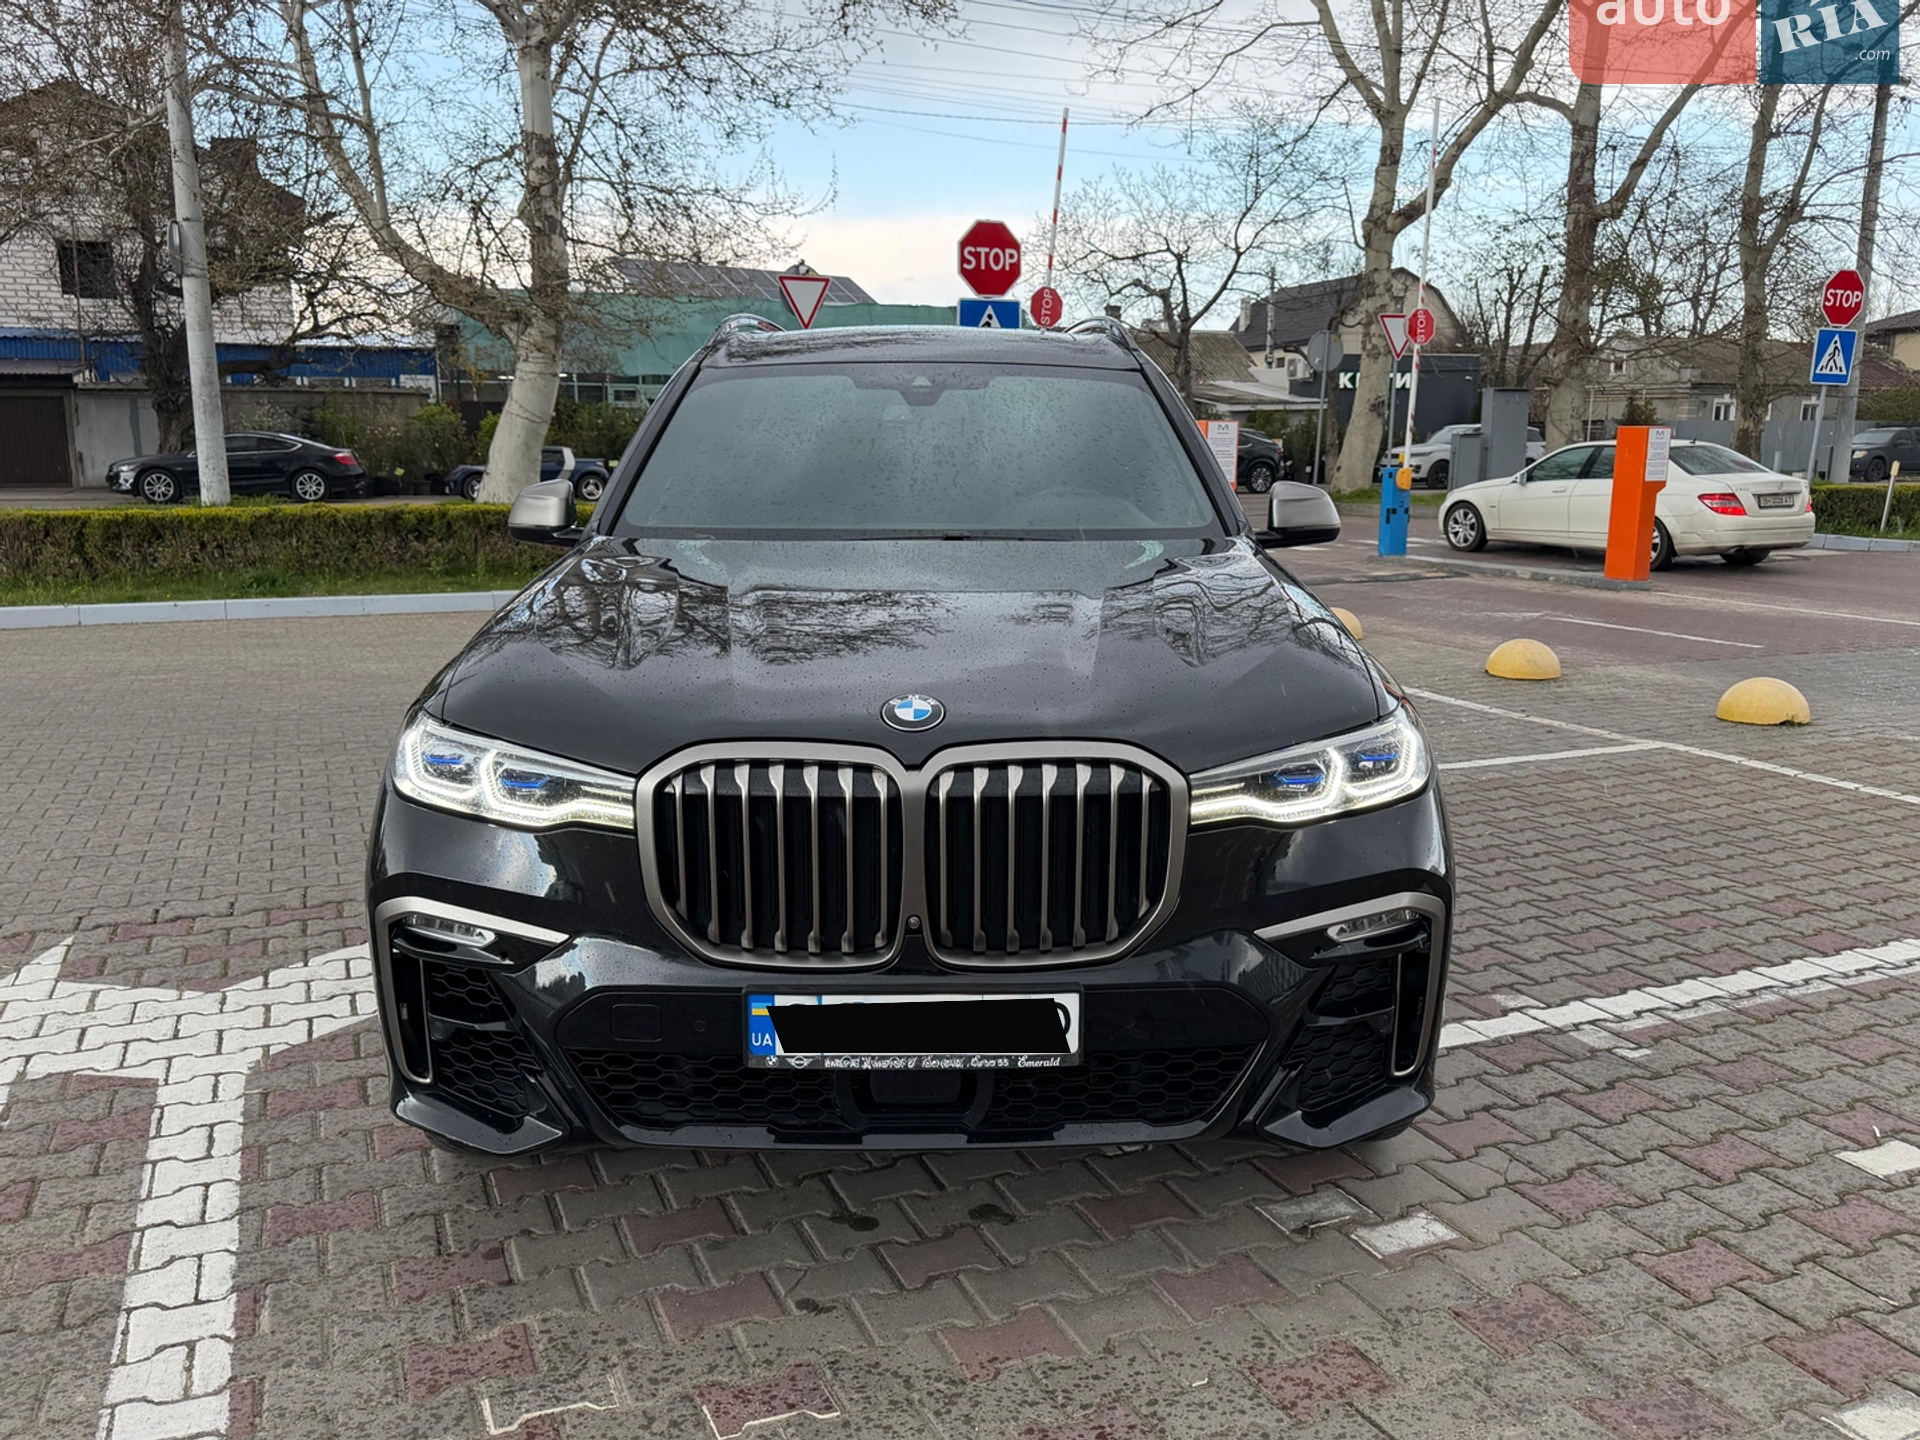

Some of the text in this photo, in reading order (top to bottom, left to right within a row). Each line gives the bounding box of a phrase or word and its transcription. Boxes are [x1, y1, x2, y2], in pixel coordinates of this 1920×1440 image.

[962, 245, 1019, 272] STOP
[1040, 288, 1053, 326] STOP
[1826, 288, 1863, 308] STOP
[1416, 310, 1427, 343] STOP
[751, 1032, 773, 1047] UA
[1017, 1054, 1062, 1069] Emerald
